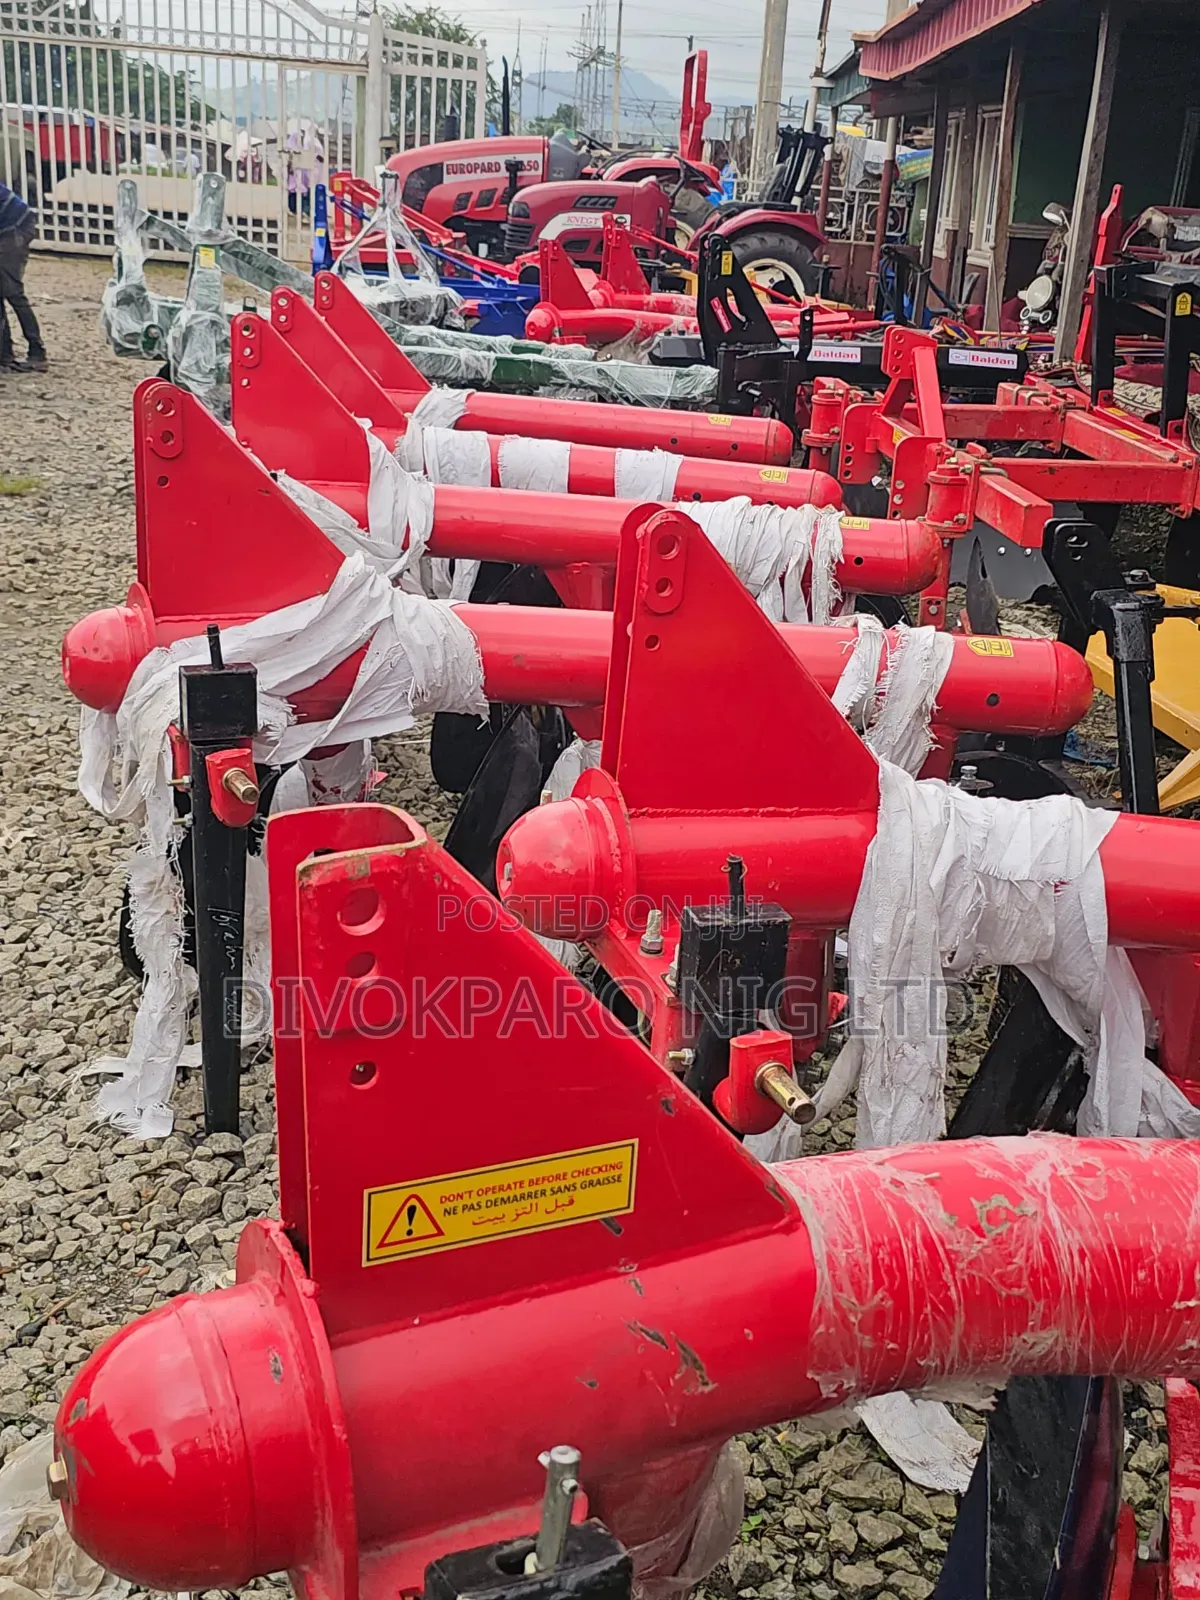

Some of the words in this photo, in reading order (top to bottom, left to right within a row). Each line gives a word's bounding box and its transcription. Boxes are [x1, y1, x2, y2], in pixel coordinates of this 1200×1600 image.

[446, 162, 501, 175] EUROPARD
[567, 215, 599, 225] KNEGT
[814, 350, 858, 359] Baldan
[971, 352, 1015, 366] Baldan
[440, 1190, 473, 1204] DON'T
[476, 1180, 525, 1196] OPERATE
[528, 1172, 568, 1187] BEFORE
[571, 1161, 623, 1179] CHECKING
[443, 1206, 458, 1217] NE
[462, 1201, 482, 1214] PAS
[485, 1189, 547, 1209] DEMARRER
[550, 1182, 577, 1196] SANS
[580, 1174, 622, 1190] GRAISSE
[545, 1195, 575, 1215] قبل
